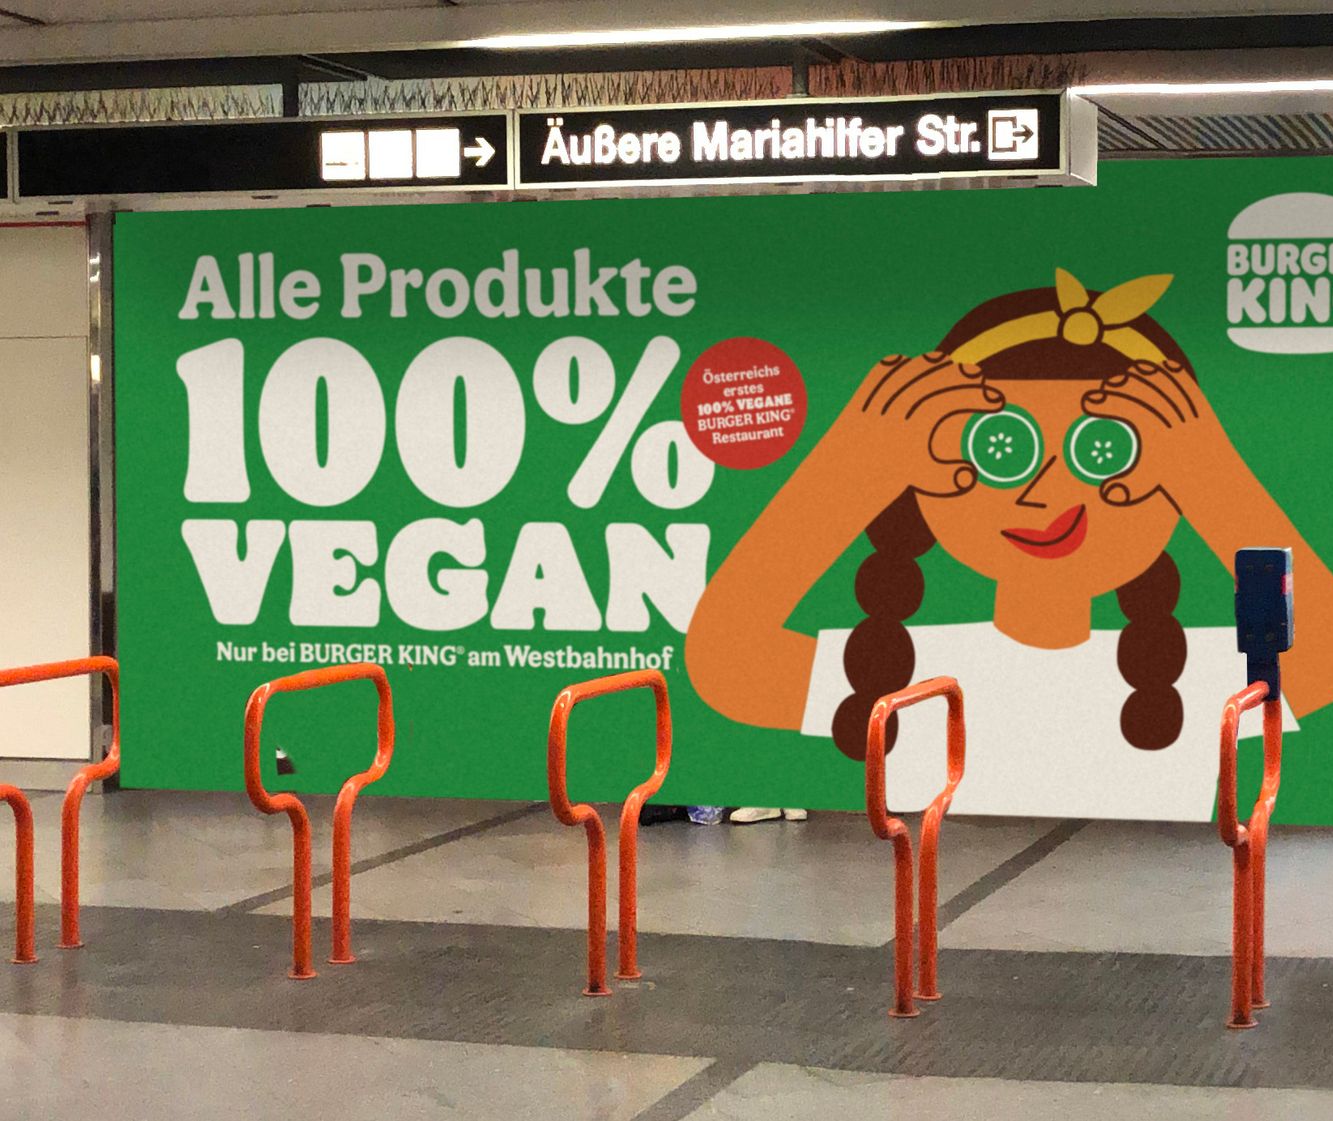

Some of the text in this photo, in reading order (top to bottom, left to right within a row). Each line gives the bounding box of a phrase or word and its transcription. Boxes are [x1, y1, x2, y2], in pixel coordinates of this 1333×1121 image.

[541, 114, 981, 165] Äußere Mariahilfer Str.
[178, 248, 698, 319] Alle Produkte
[702, 365, 780, 384] Österreichs
[723, 384, 764, 397] erstes
[697, 393, 793, 416] 100% VEGANE
[176, 335, 715, 510] 100%
[698, 413, 753, 431] BURGER
[712, 426, 785, 444] Restaurant
[181, 517, 711, 633] VEGAN
[216, 641, 256, 662] Nur
[262, 641, 296, 663] bei
[301, 644, 393, 664] BURGER
[468, 650, 500, 667] am
[504, 645, 674, 671] Westbahnhof
